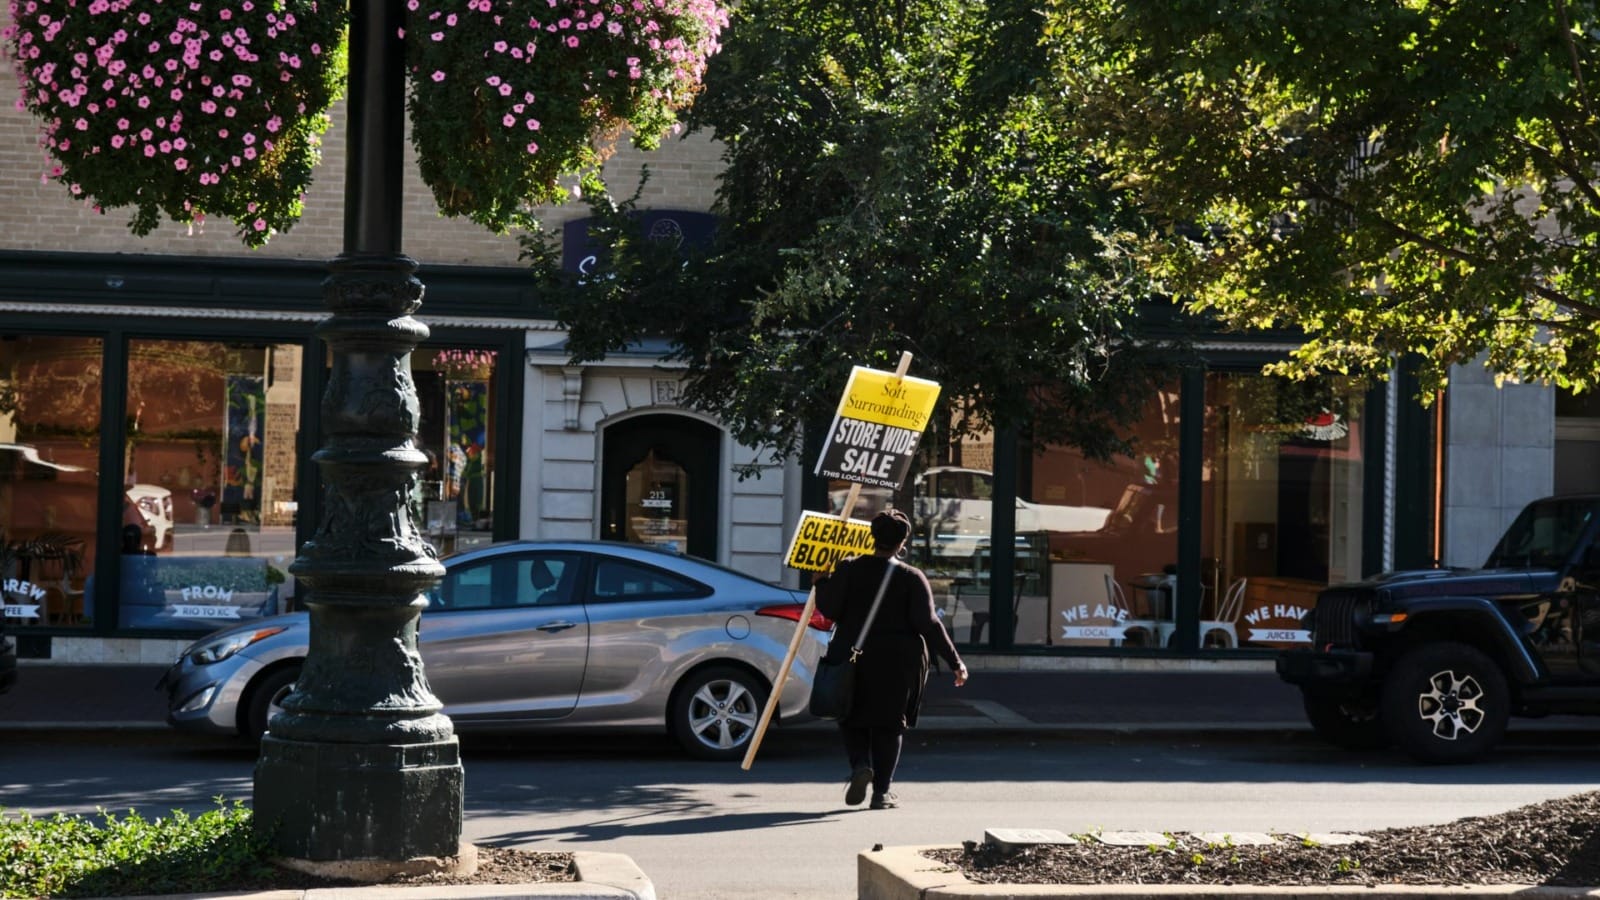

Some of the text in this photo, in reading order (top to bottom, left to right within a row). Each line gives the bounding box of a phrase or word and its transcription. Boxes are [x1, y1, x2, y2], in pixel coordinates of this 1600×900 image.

[881, 382, 906, 400] Soft
[846, 394, 926, 427] Surroundings
[835, 418, 919, 456] STORE WIDE
[840, 448, 895, 478] SALE
[823, 470, 900, 489] THIS LOCATION ONLY
[803, 520, 875, 551] CLEARANC
[794, 543, 861, 568] BLOW
[181, 585, 233, 602] FROM
[183, 607, 200, 616] RIO
[202, 607, 215, 616] TO
[1061, 603, 1129, 624] WE ARE
[1244, 604, 1309, 625] WE HAV
[1080, 628, 1110, 637] LOCAL
[1265, 631, 1296, 640] JUICES
